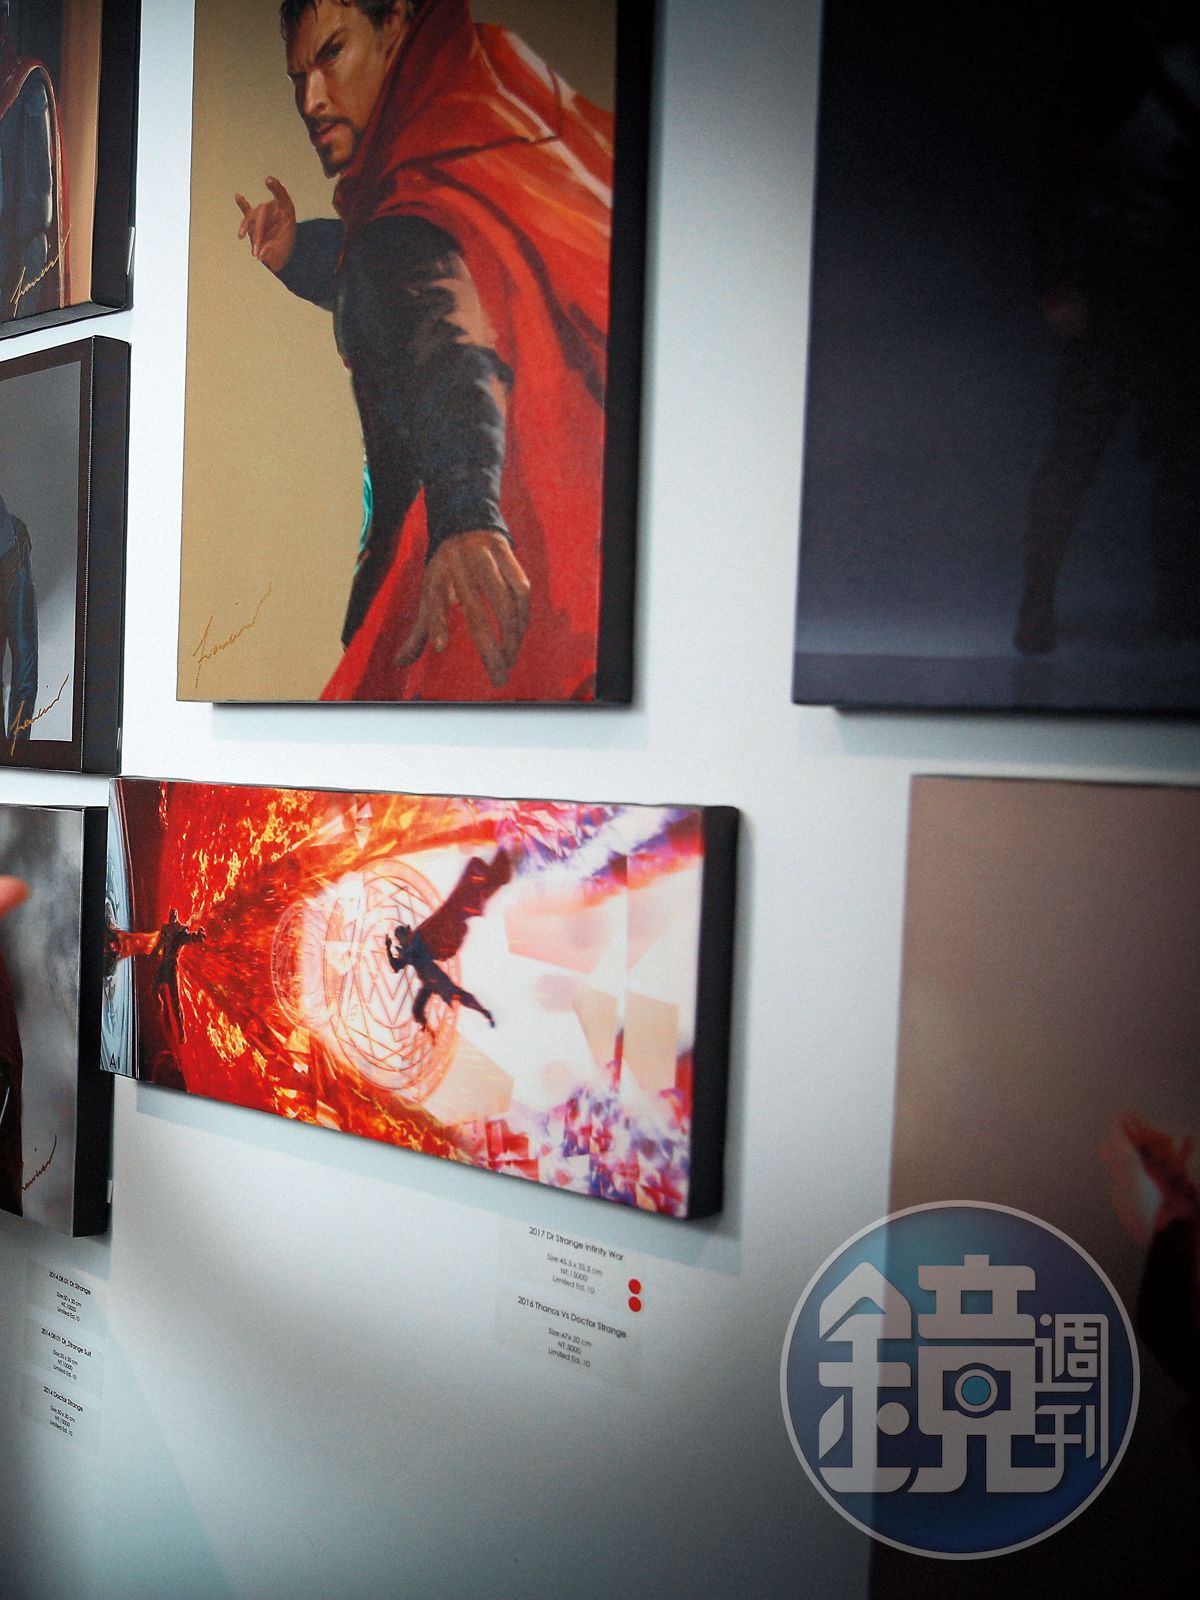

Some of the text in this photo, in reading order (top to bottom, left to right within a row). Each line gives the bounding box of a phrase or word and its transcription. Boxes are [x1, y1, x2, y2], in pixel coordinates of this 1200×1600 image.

[529, 1226, 545, 1237] 2017
[555, 1234, 584, 1250] Strange
[608, 1249, 624, 1261] War
[518, 1296, 533, 1308] 2016
[535, 1302, 559, 1316] Thanos
[571, 1313, 596, 1327] Doctor
[597, 1322, 626, 1338] Strange
